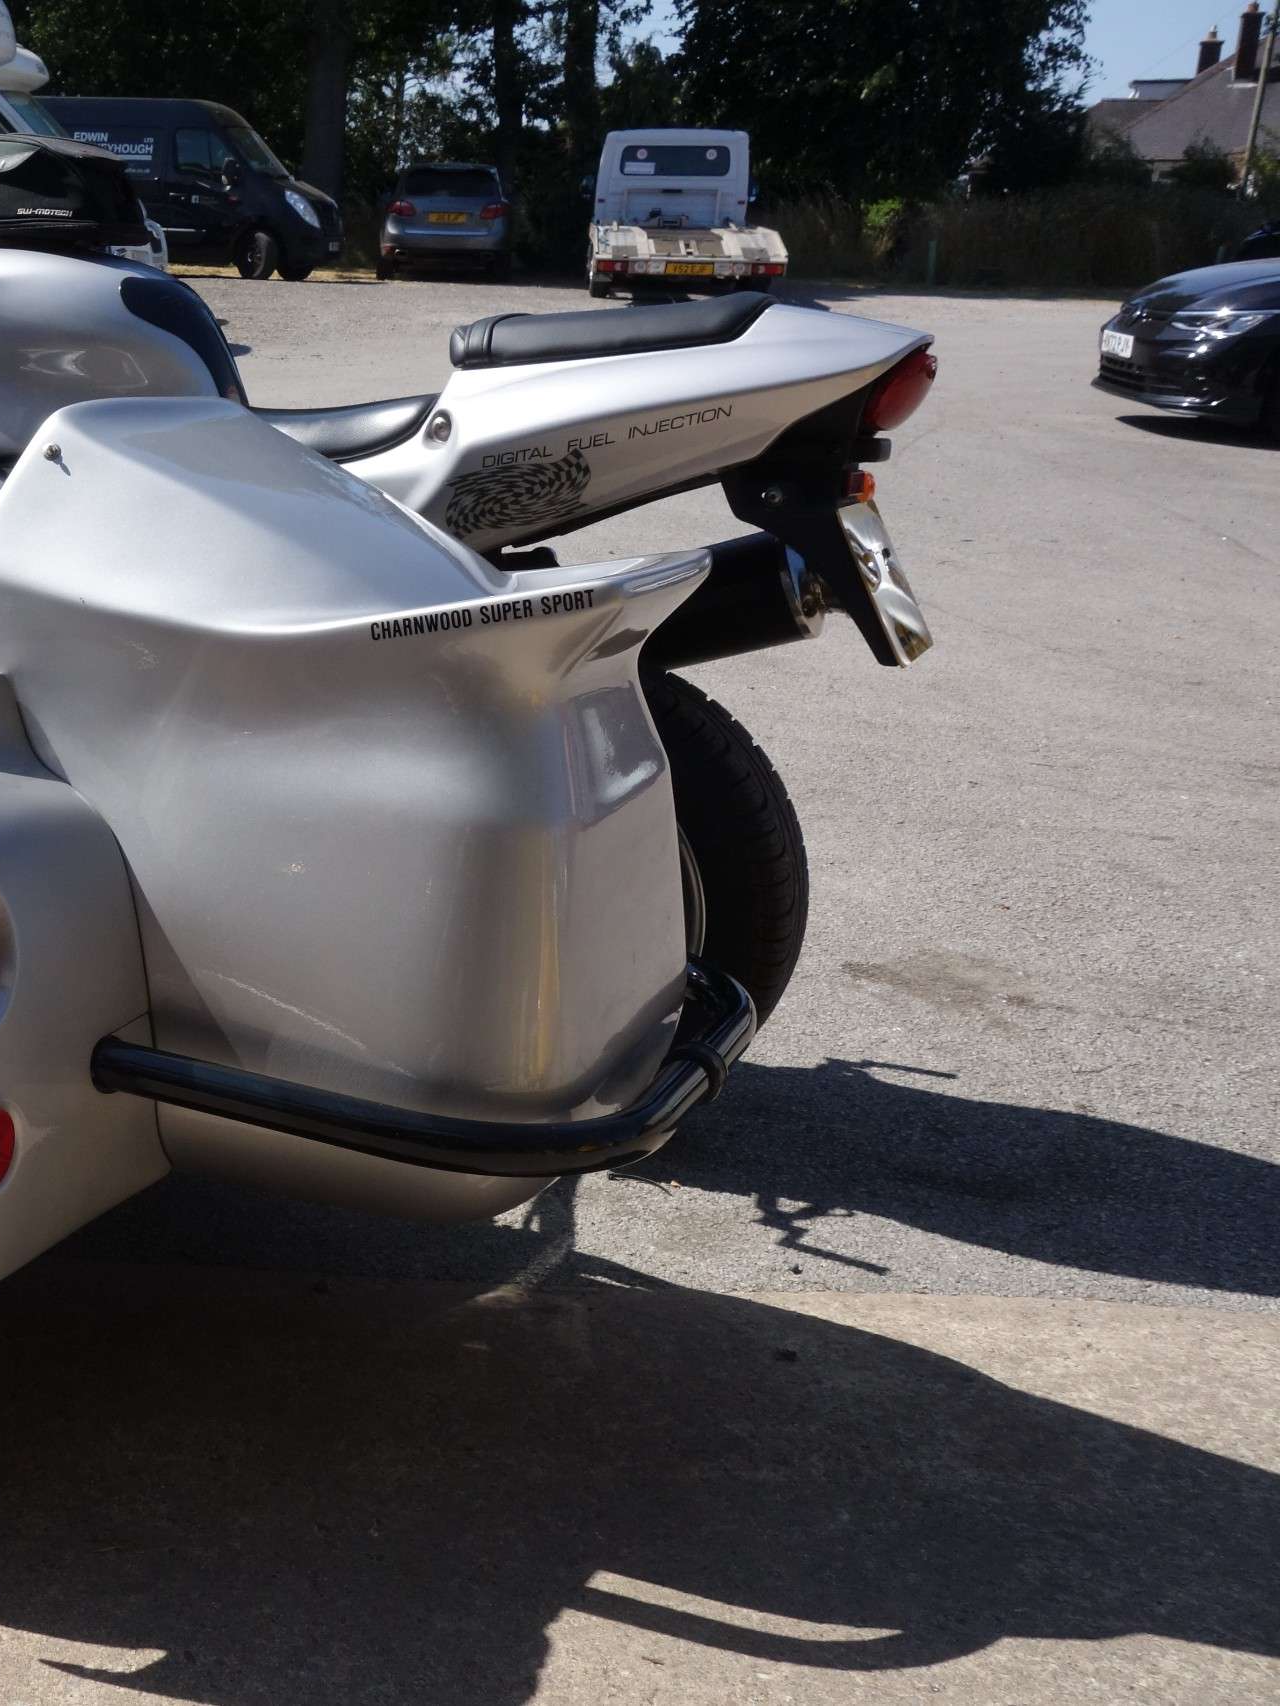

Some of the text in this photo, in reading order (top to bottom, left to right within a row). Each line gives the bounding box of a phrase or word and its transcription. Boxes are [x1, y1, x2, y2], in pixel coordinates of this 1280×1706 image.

[73, 131, 109, 142] EDWIN
[17, 208, 73, 217] SW-MOTECH
[482, 405, 733, 468] DIGITAL FUEL INJECTION
[370, 589, 595, 641] CHARNWOOD SUPER SPORT
